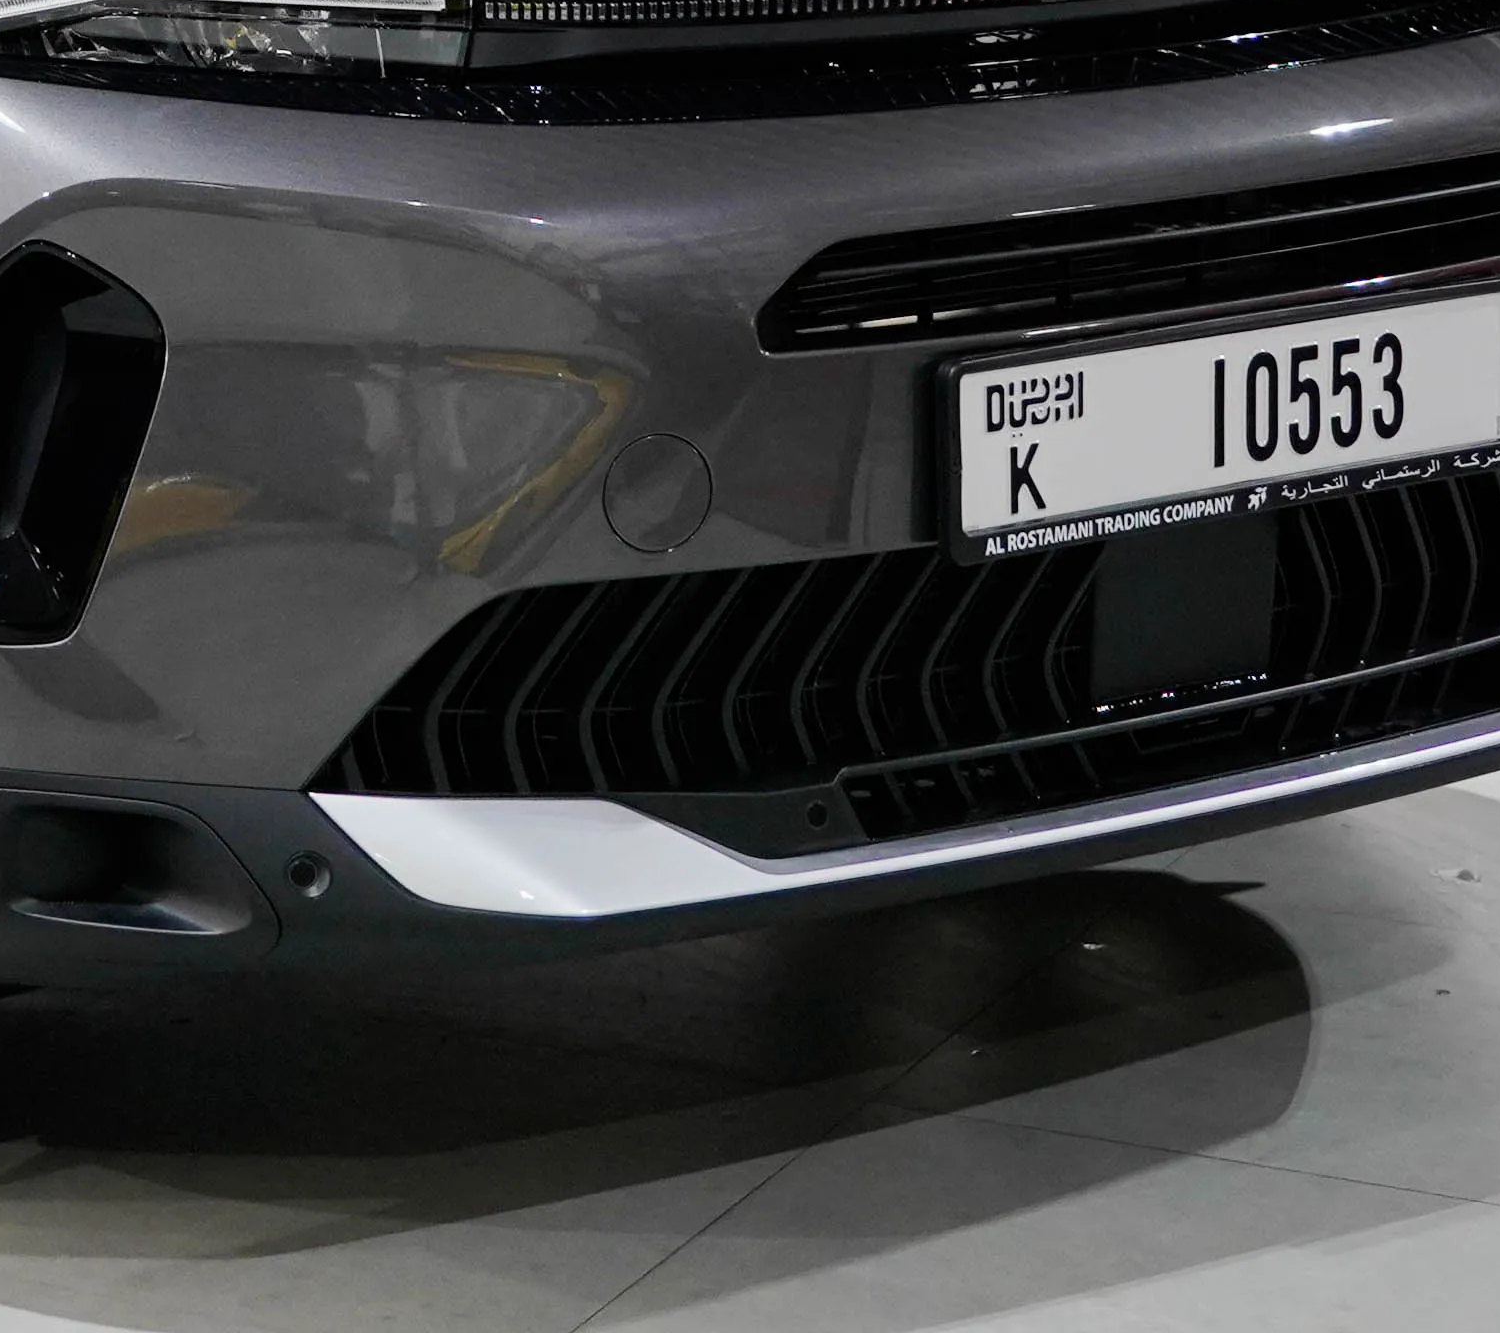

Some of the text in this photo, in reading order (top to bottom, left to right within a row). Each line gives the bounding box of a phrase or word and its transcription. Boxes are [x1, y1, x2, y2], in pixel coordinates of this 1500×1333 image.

[986, 371, 1084, 433] DUBAI
[1213, 332, 1404, 469] 10553
[1010, 442, 1047, 514] K
[1280, 475, 1349, 500] التجارية
[1361, 459, 1440, 490] الرستماني
[985, 494, 1235, 556] AL ROSTAMANI TRADING COMPANY
